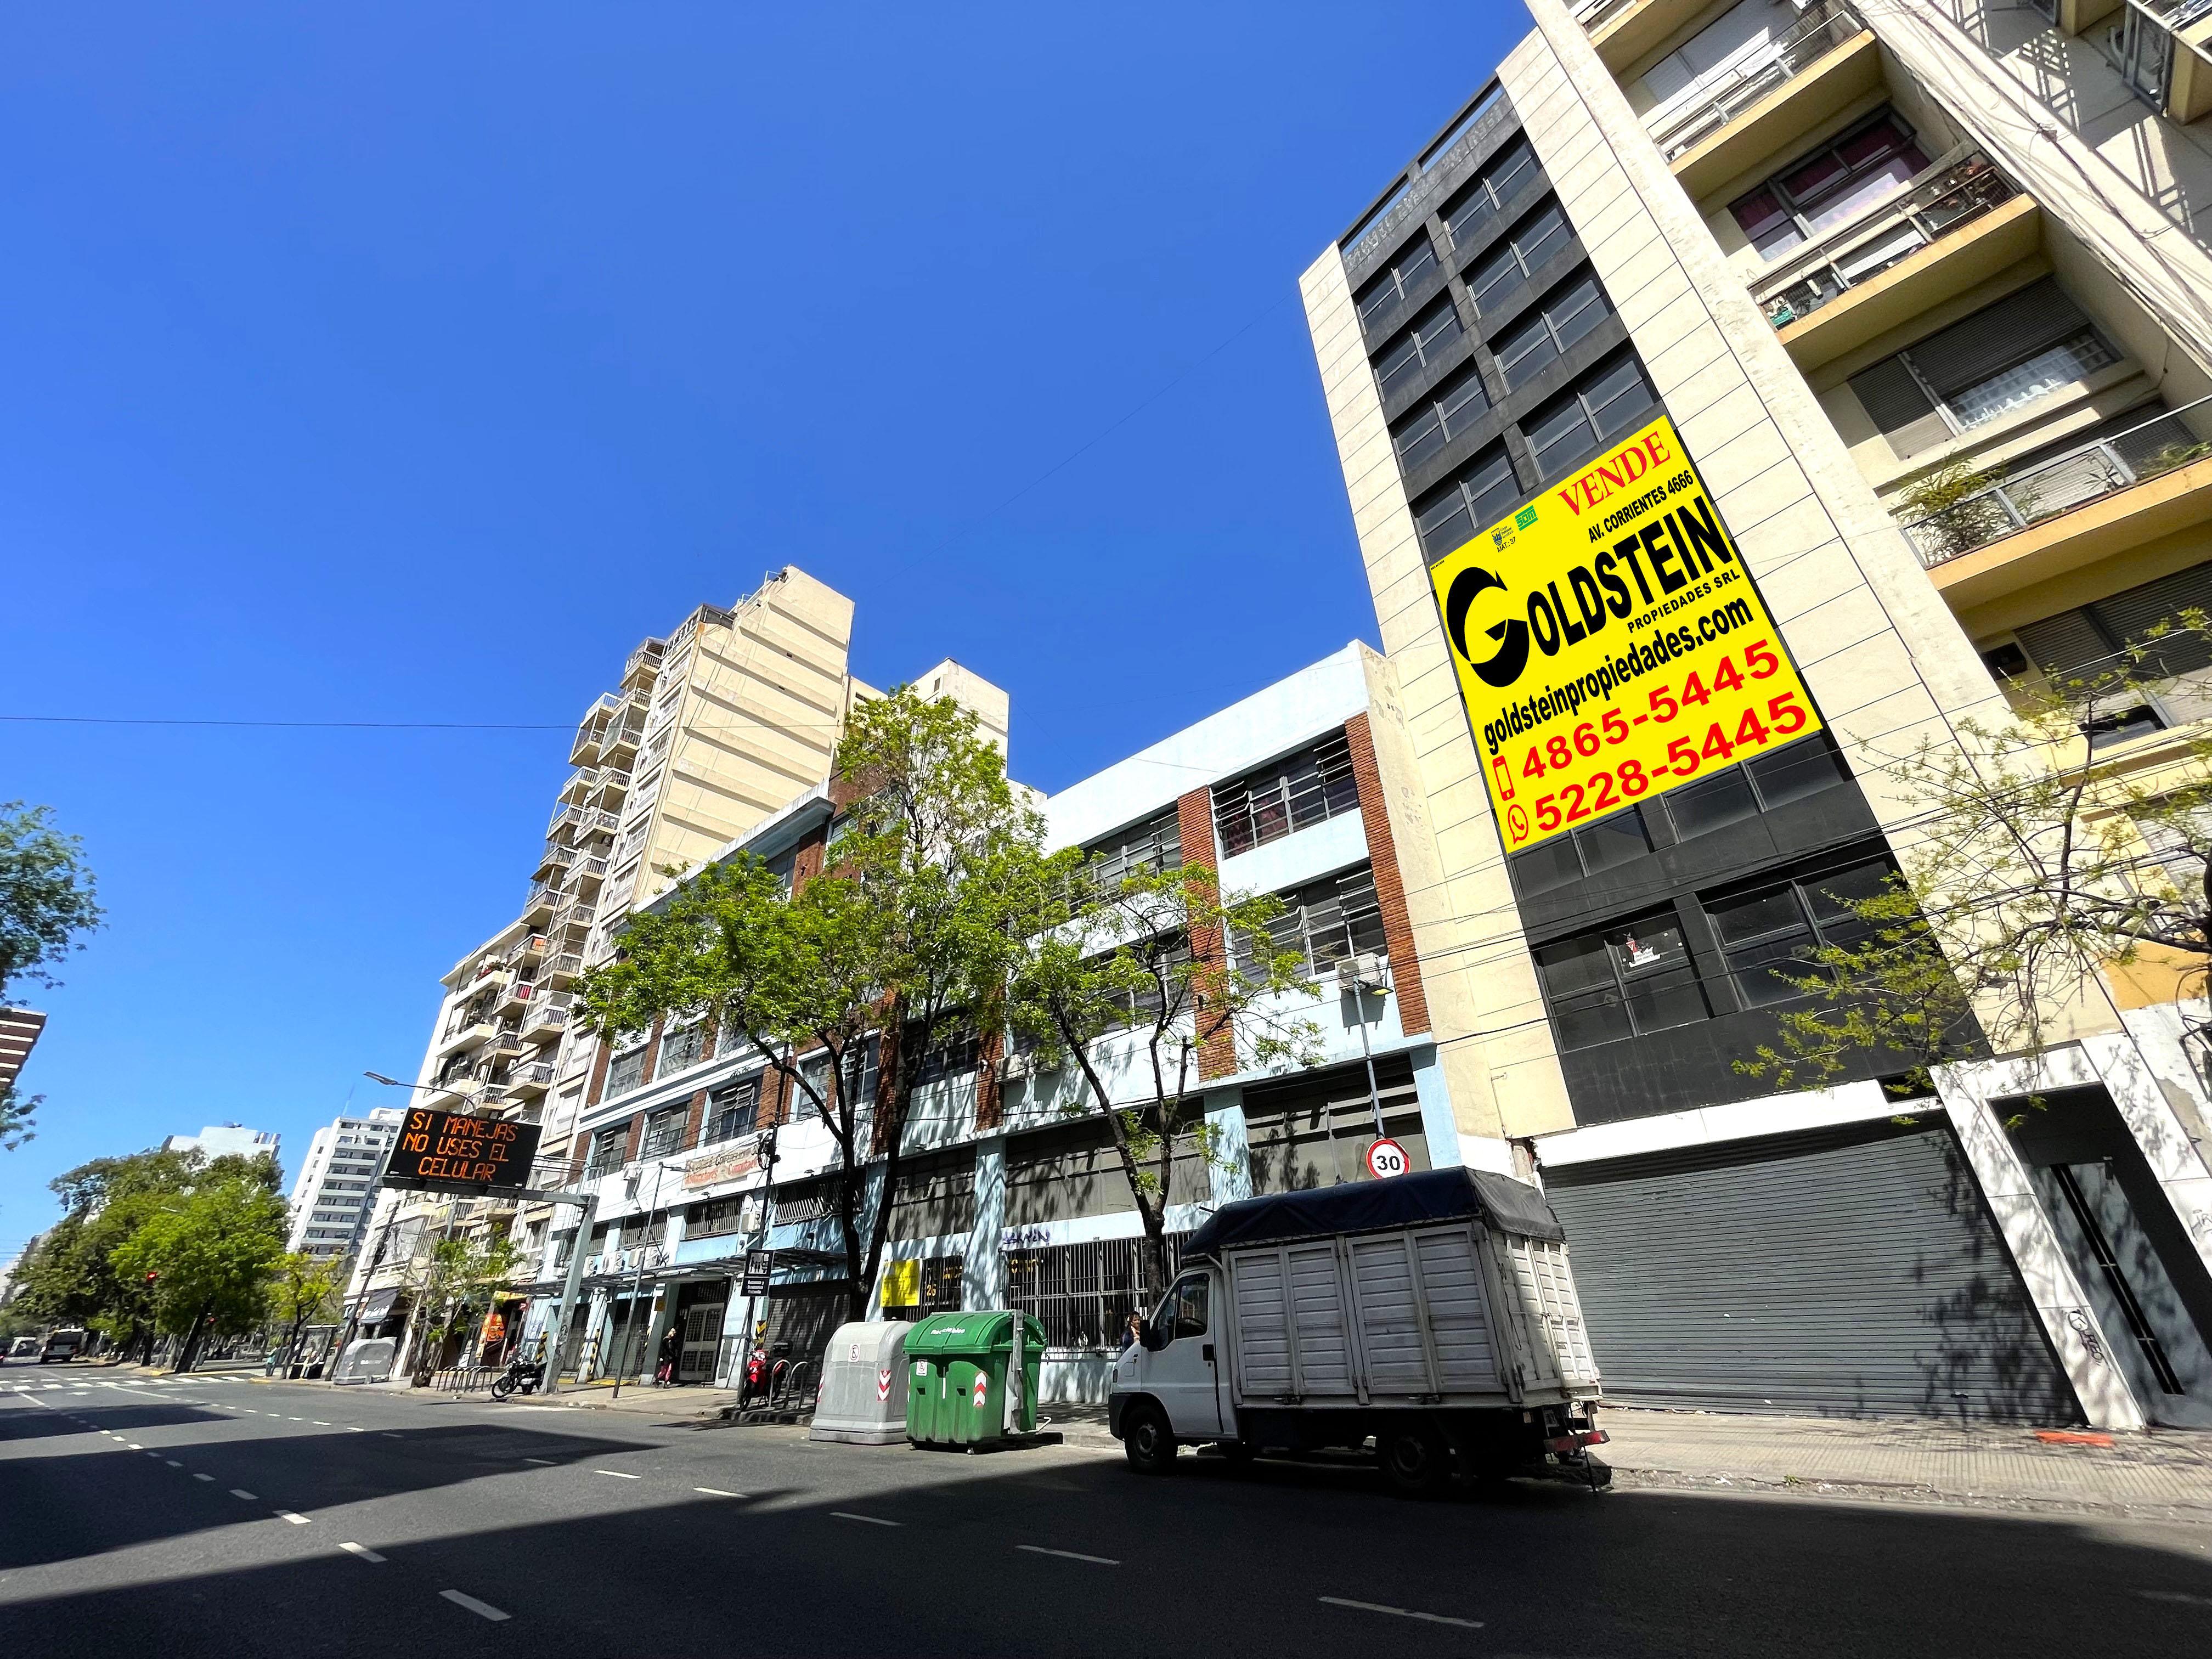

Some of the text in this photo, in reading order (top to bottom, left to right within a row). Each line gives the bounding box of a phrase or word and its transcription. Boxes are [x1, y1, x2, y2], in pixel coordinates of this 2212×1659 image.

[1558, 431, 1670, 515] VENDE
[1589, 470, 1693, 543] AV. CORRIENTES 4666
[1497, 536, 1516, 553] MAT.: 37
[1447, 495, 1733, 687] GOLDSTEIN
[1627, 569, 1740, 634] PROPIEDADES SRL
[1484, 597, 1754, 756] goldsteinpropiedades.com
[1523, 639, 1779, 778] 4865-5445
[1536, 691, 1806, 831] 5228-5445
[402, 1132, 509, 1162] NO USES EL
[410, 1111, 518, 1142] SI MANEJAS
[418, 1156, 496, 1181] CELULAR
[1376, 1155, 1401, 1171] 30
